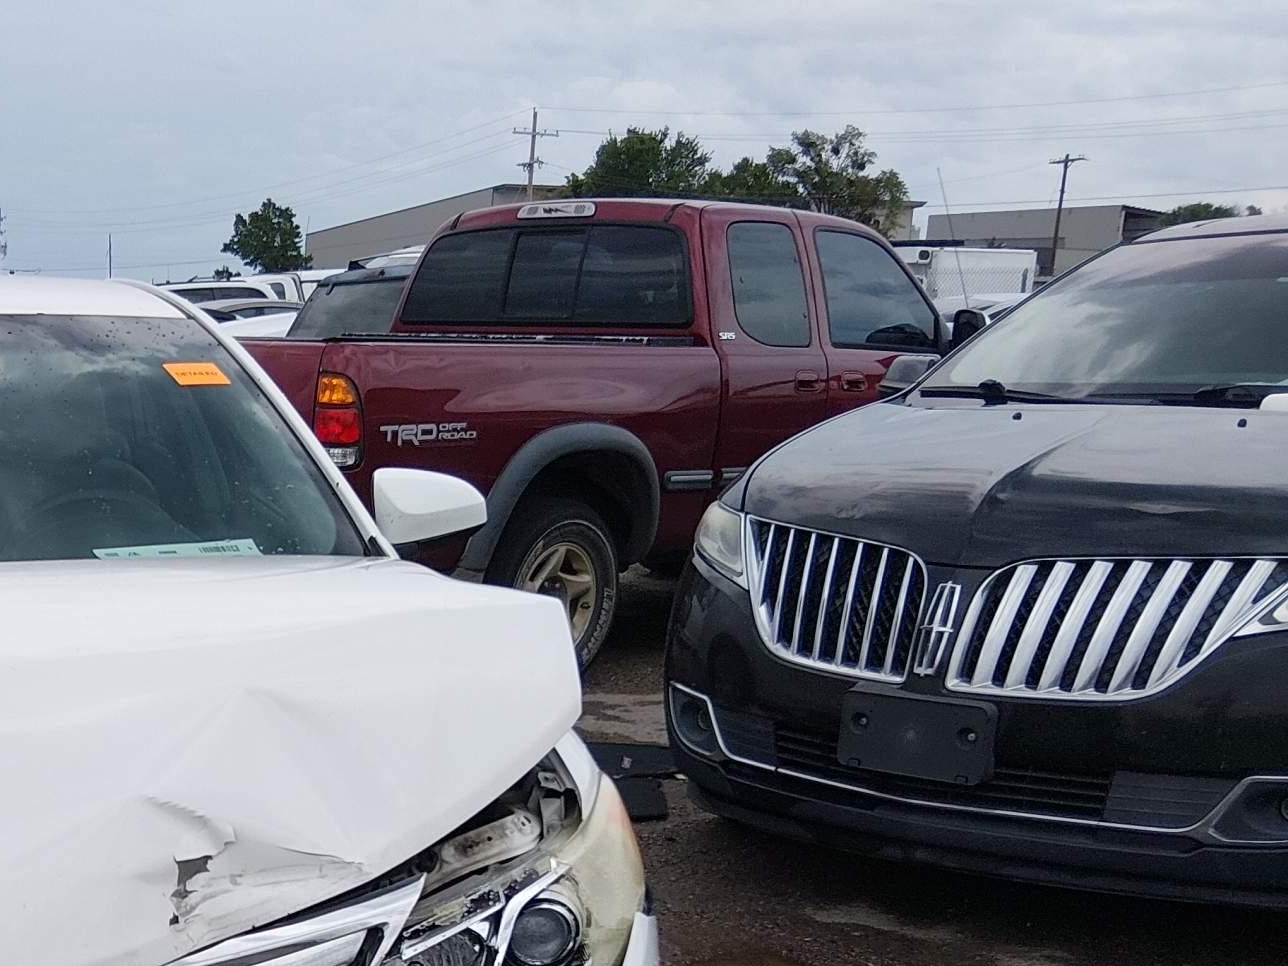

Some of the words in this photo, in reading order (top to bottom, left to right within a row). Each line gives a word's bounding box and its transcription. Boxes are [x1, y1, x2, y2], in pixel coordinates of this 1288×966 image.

[438, 422, 468, 431] OFF
[379, 423, 438, 446] TRD
[438, 431, 477, 440] ROAD
